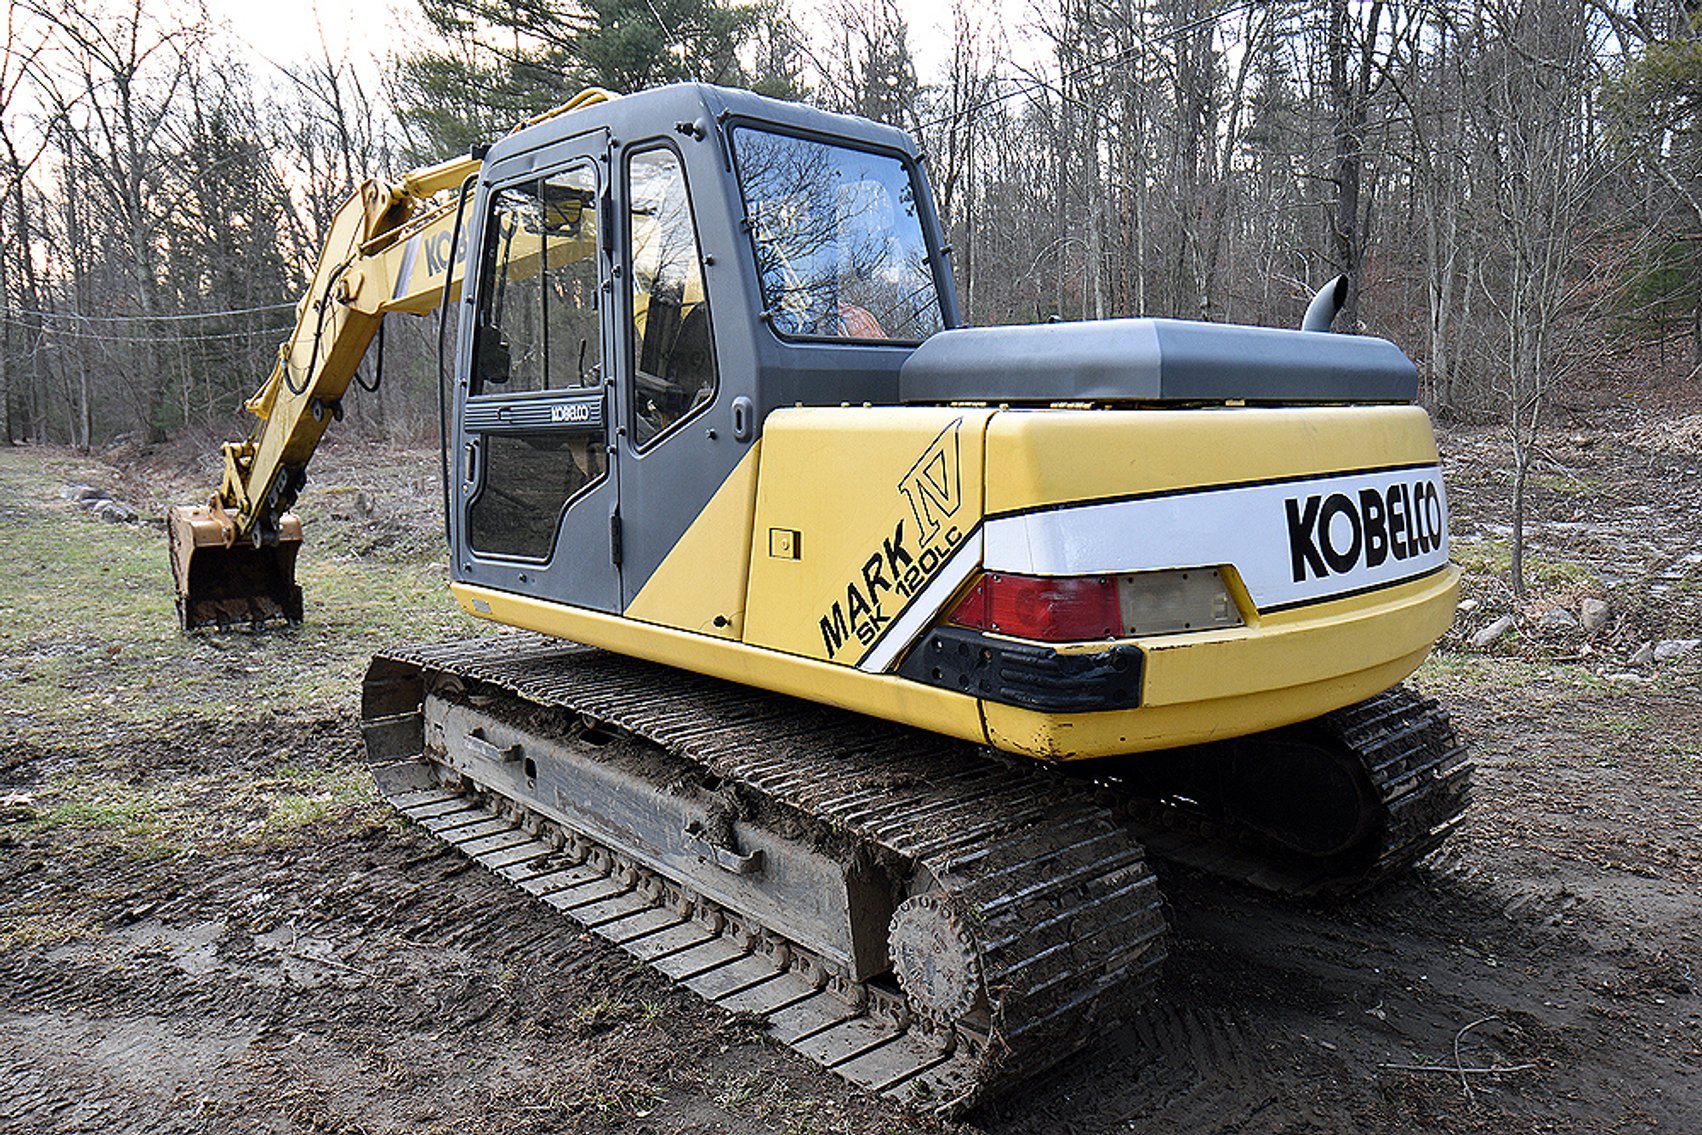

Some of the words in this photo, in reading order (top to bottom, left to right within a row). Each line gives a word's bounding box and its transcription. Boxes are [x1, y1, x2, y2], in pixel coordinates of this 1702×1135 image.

[819, 518, 914, 660] MARK
[897, 416, 964, 549] IV
[856, 603, 891, 647] SK
[895, 526, 963, 599] 120LC
[1285, 480, 1442, 583] KOBELCO
